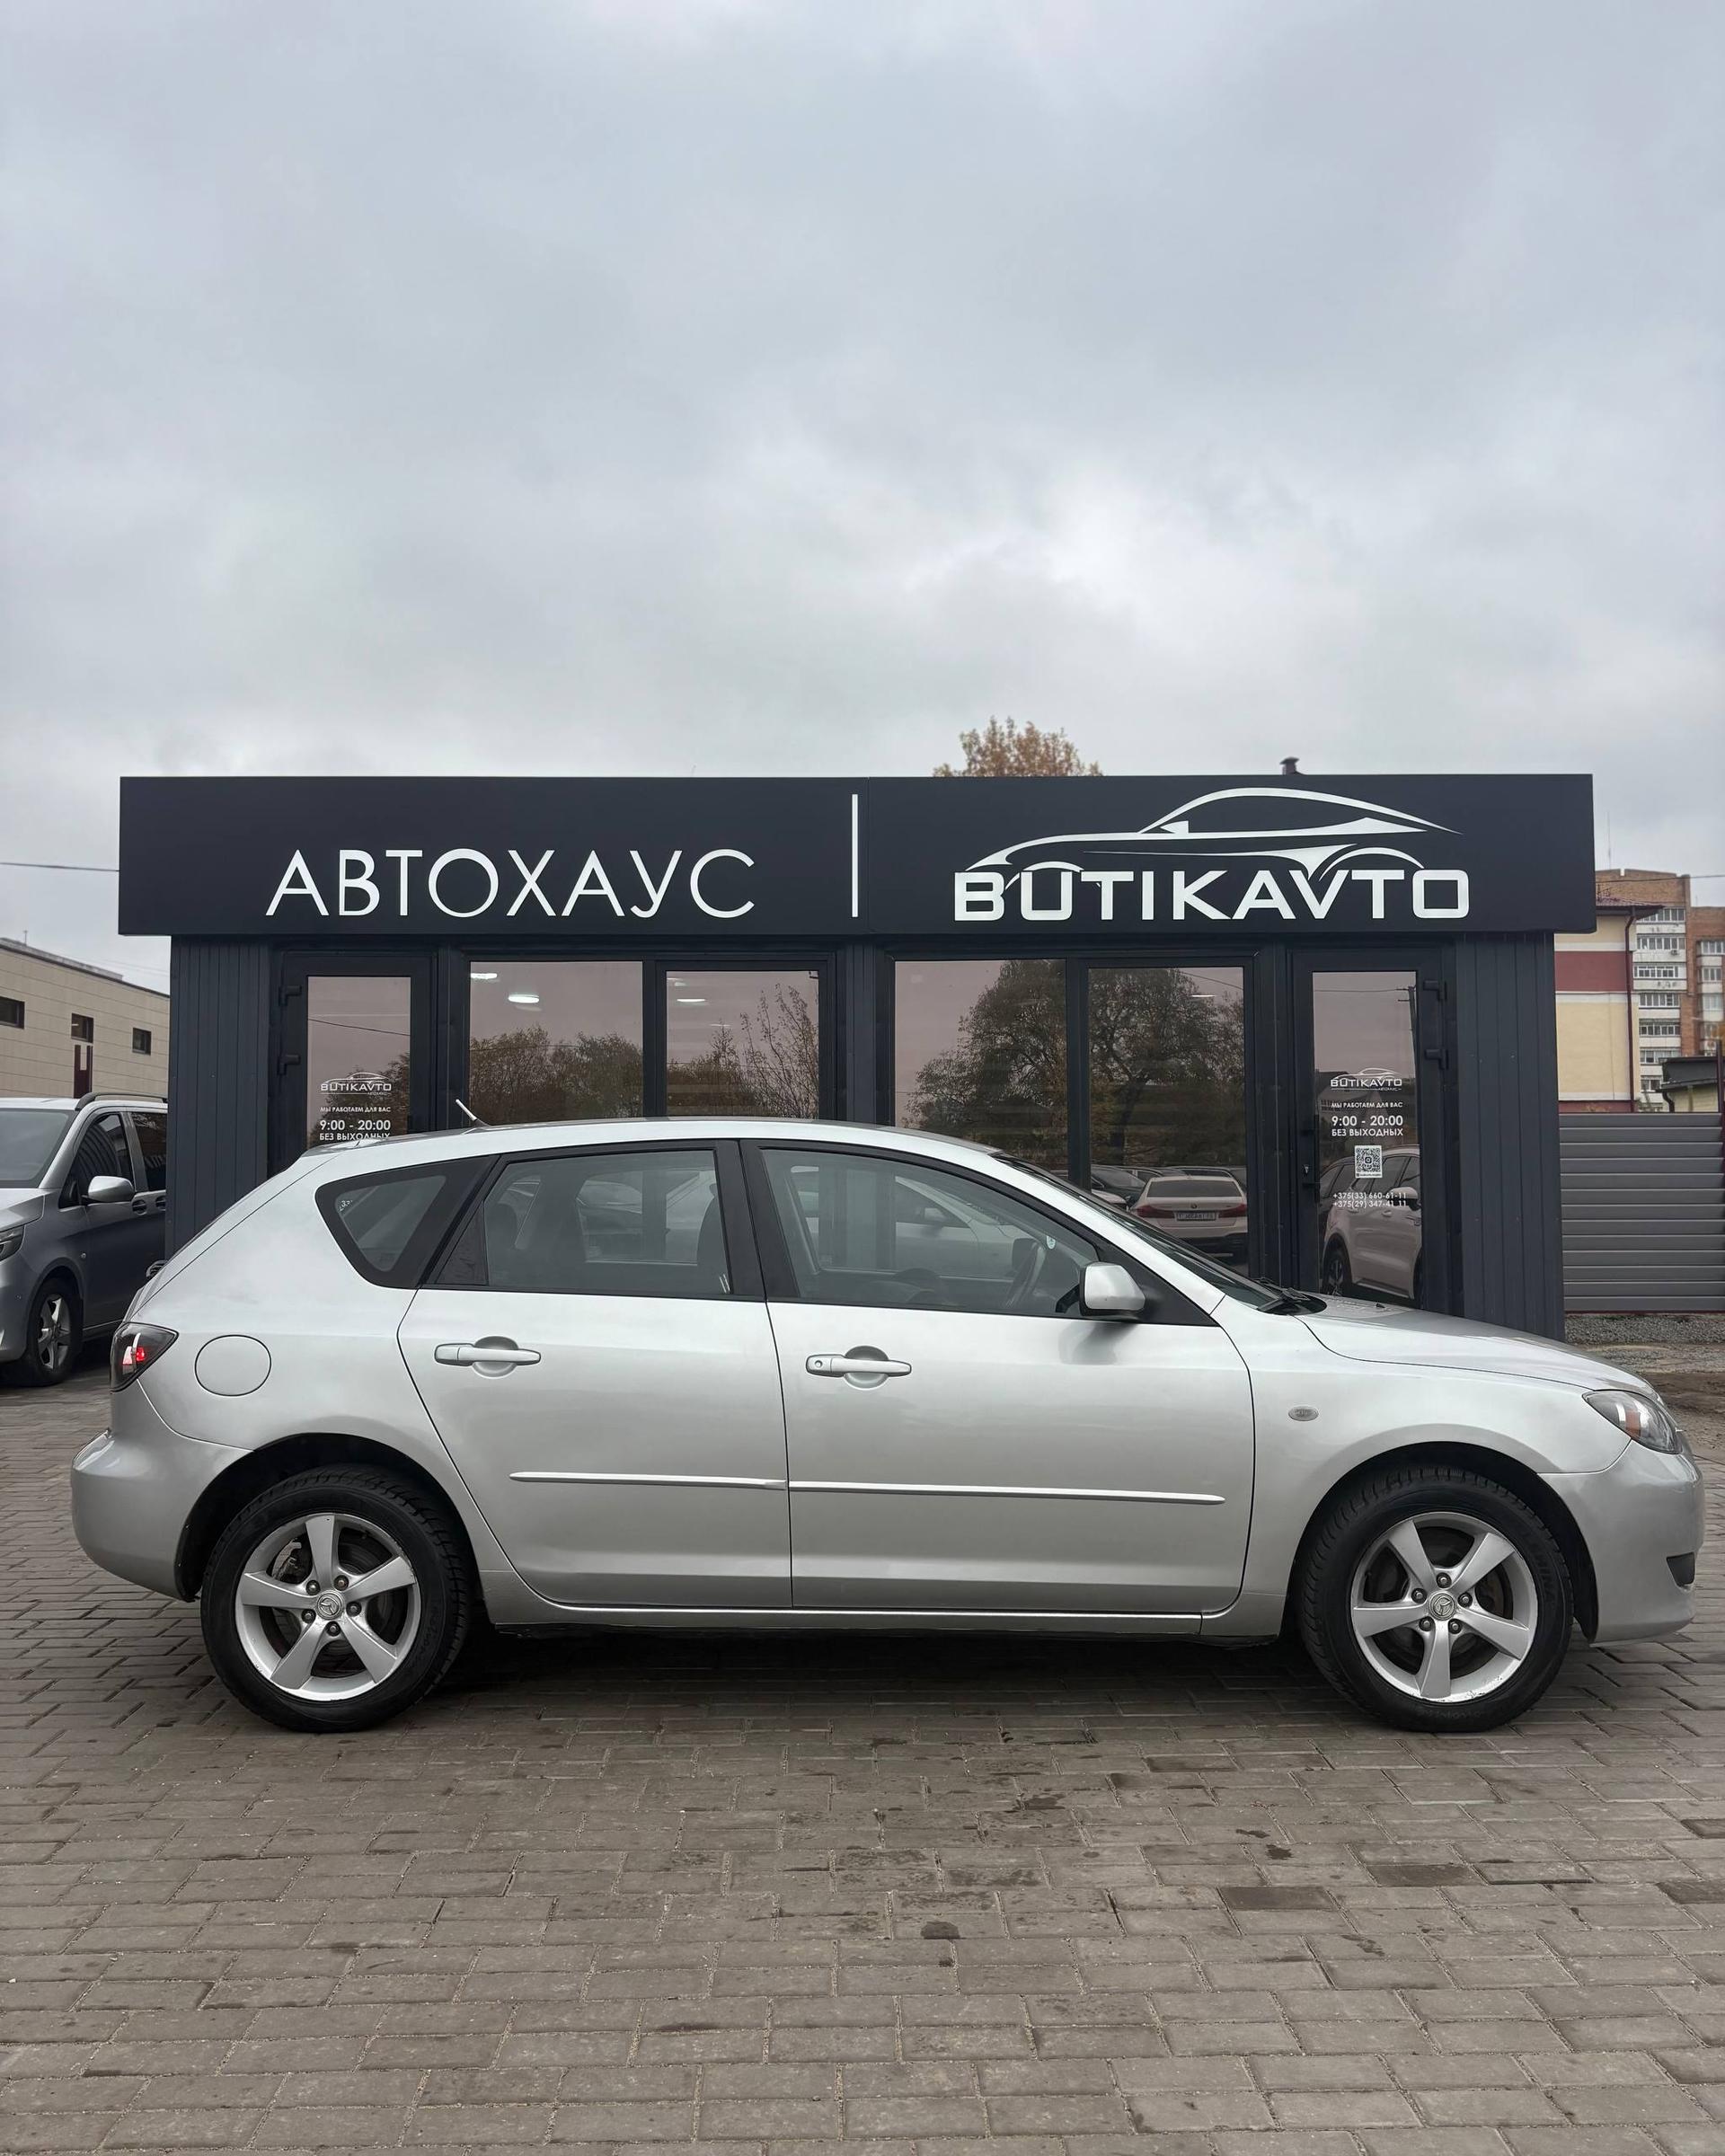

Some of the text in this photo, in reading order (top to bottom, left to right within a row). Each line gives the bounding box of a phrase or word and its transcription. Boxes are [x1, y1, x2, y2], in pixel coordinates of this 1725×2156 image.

[266, 848, 756, 918] АВТОХАУС
[954, 869, 1469, 922] BUTIKAVTO
[320, 1082, 392, 1091] BUTIKAVTO
[1331, 1078, 1402, 1087] BUTIKAVTO
[320, 1120, 346, 1131] 9:00
[358, 1119, 392, 1131] 20:00
[1331, 1116, 1358, 1127] 9:00
[1370, 1115, 1403, 1127] 20:00
[1331, 1128, 1403, 1136] БЕЗ ВЫХОДНЫХ
[320, 1133, 334, 1141] БЕЗ
[1332, 1192, 1367, 1201] +375(33)
